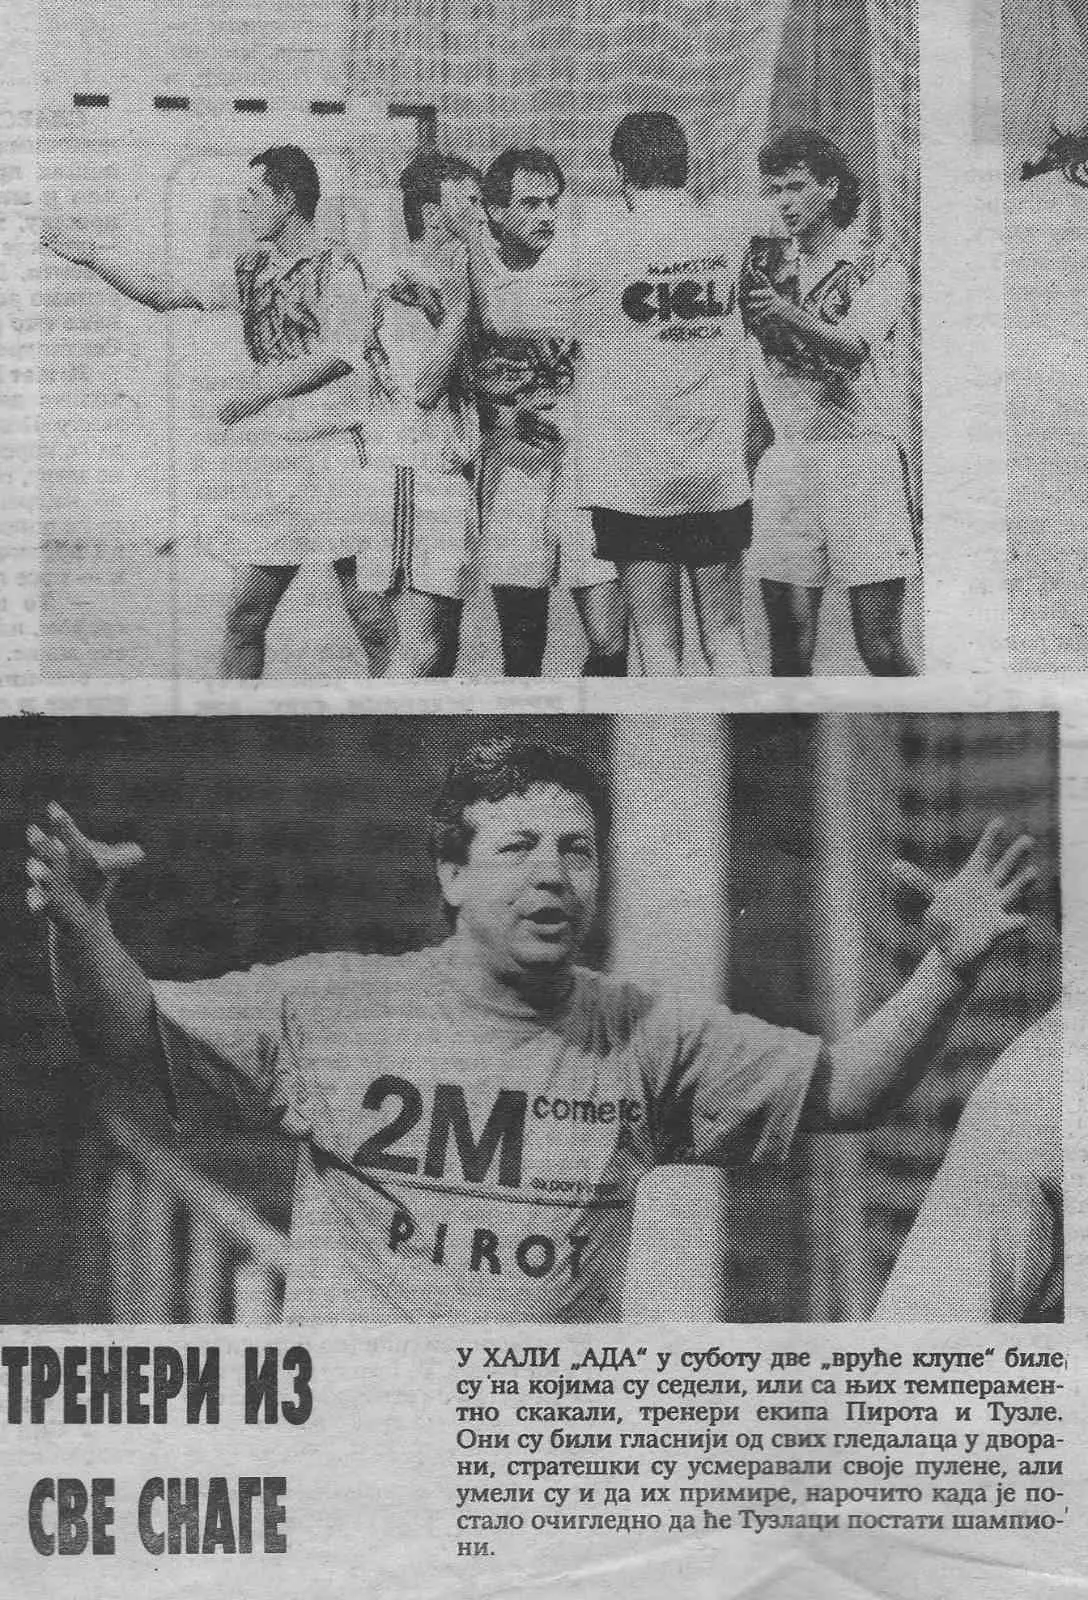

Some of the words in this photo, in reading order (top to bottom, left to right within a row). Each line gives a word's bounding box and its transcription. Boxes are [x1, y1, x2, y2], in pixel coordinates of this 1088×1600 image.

[351, 1074, 528, 1188] 2M
[387, 1207, 592, 1284] PIROT
[455, 1345, 474, 1368] У
[483, 1347, 560, 1367] ХАЛИ
[656, 1352, 672, 1372] у
[681, 1346, 762, 1372] суботу
[770, 1352, 810, 1370] две
[1, 1346, 219, 1424] ТРЕНЕРИ
[245, 1346, 312, 1425] ИЗ
[456, 1379, 483, 1401] су
[490, 1379, 519, 1395] на
[528, 1374, 615, 1400] којима
[623, 1379, 650, 1400] су
[657, 1379, 747, 1400] седели,
[756, 1379, 803, 1394] или
[811, 1379, 836, 1394] са
[844, 1380, 896, 1394] њих
[904, 1379, 1064, 1399] темперамен-
[456, 1406, 500, 1422] тно
[516, 1406, 624, 1424] скакали,
[639, 1406, 740, 1426] тренери
[756, 1406, 829, 1421] екипа
[845, 1401, 938, 1426] Пирота
[955, 1407, 971, 1421] и
[987, 1401, 1063, 1427] Тузле.
[456, 1429, 510, 1449] Они
[517, 1434, 544, 1454] су
[550, 1428, 612, 1448] били
[620, 1428, 728, 1454] гласнији
[736, 1433, 764, 1451] од
[771, 1433, 827, 1448] свих
[833, 1432, 958, 1452] гледалаца
[964, 1434, 980, 1454] у
[985, 1434, 1064, 1453] двора-
[457, 1461, 495, 1478] ни,
[507, 1460, 640, 1480] стратешки
[651, 1460, 678, 1480] су
[688, 1459, 832, 1480] усмеравали
[843, 1456, 904, 1480] своје
[915, 1460, 1007, 1480] пулене,
[1018, 1461, 1063, 1476] али
[456, 1488, 534, 1508] умели
[544, 1488, 571, 1507] су
[578, 1488, 595, 1502] и
[604, 1488, 631, 1506] да
[641, 1488, 671, 1502] их
[680, 1488, 797, 1507] примире,
[805, 1487, 922, 1507] нарочито
[932, 1488, 987, 1505] када
[994, 1482, 1016, 1507] је
[1026, 1488, 1064, 1502] по-
[28, 1477, 115, 1556] СВЕ
[138, 1476, 287, 1555] СНАГЕ
[457, 1514, 524, 1530] стало
[531, 1515, 662, 1533] очигледно
[668, 1515, 696, 1533] да
[704, 1509, 732, 1529] ће
[738, 1510, 840, 1534] Тузлаци
[848, 1515, 944, 1529] постати
[954, 1514, 1065, 1530] шампио-
[456, 1541, 496, 1557] ни.
